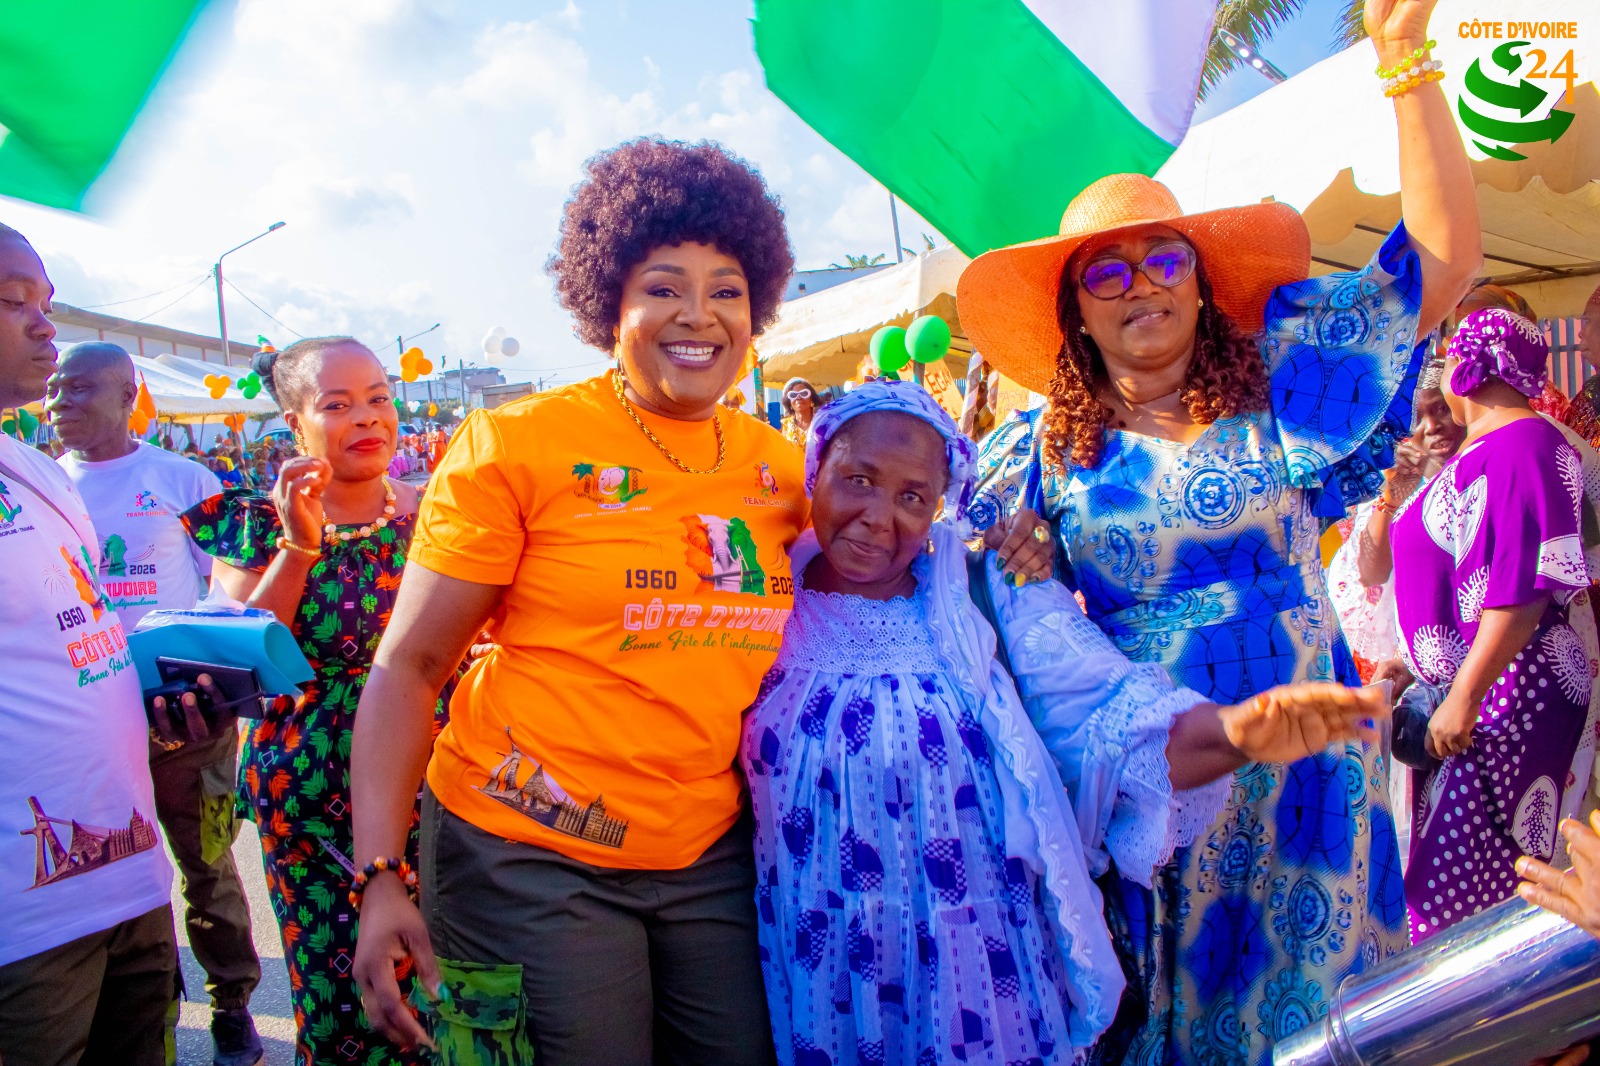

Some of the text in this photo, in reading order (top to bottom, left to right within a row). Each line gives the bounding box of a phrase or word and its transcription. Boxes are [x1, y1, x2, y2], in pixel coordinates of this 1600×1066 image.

[742, 496, 767, 506] TEAM
[129, 564, 156, 575] 2026
[625, 569, 677, 590] 1960
[770, 576, 795, 595] 202
[56, 606, 87, 632] 1960
[623, 598, 792, 635] CÔTE D'IVOIR
[66, 631, 116, 669] CÔTE
[619, 634, 662, 652] Bonne
[668, 630, 699, 651] Fête
[703, 632, 717, 648] de
[78, 668, 110, 688] Bonne
